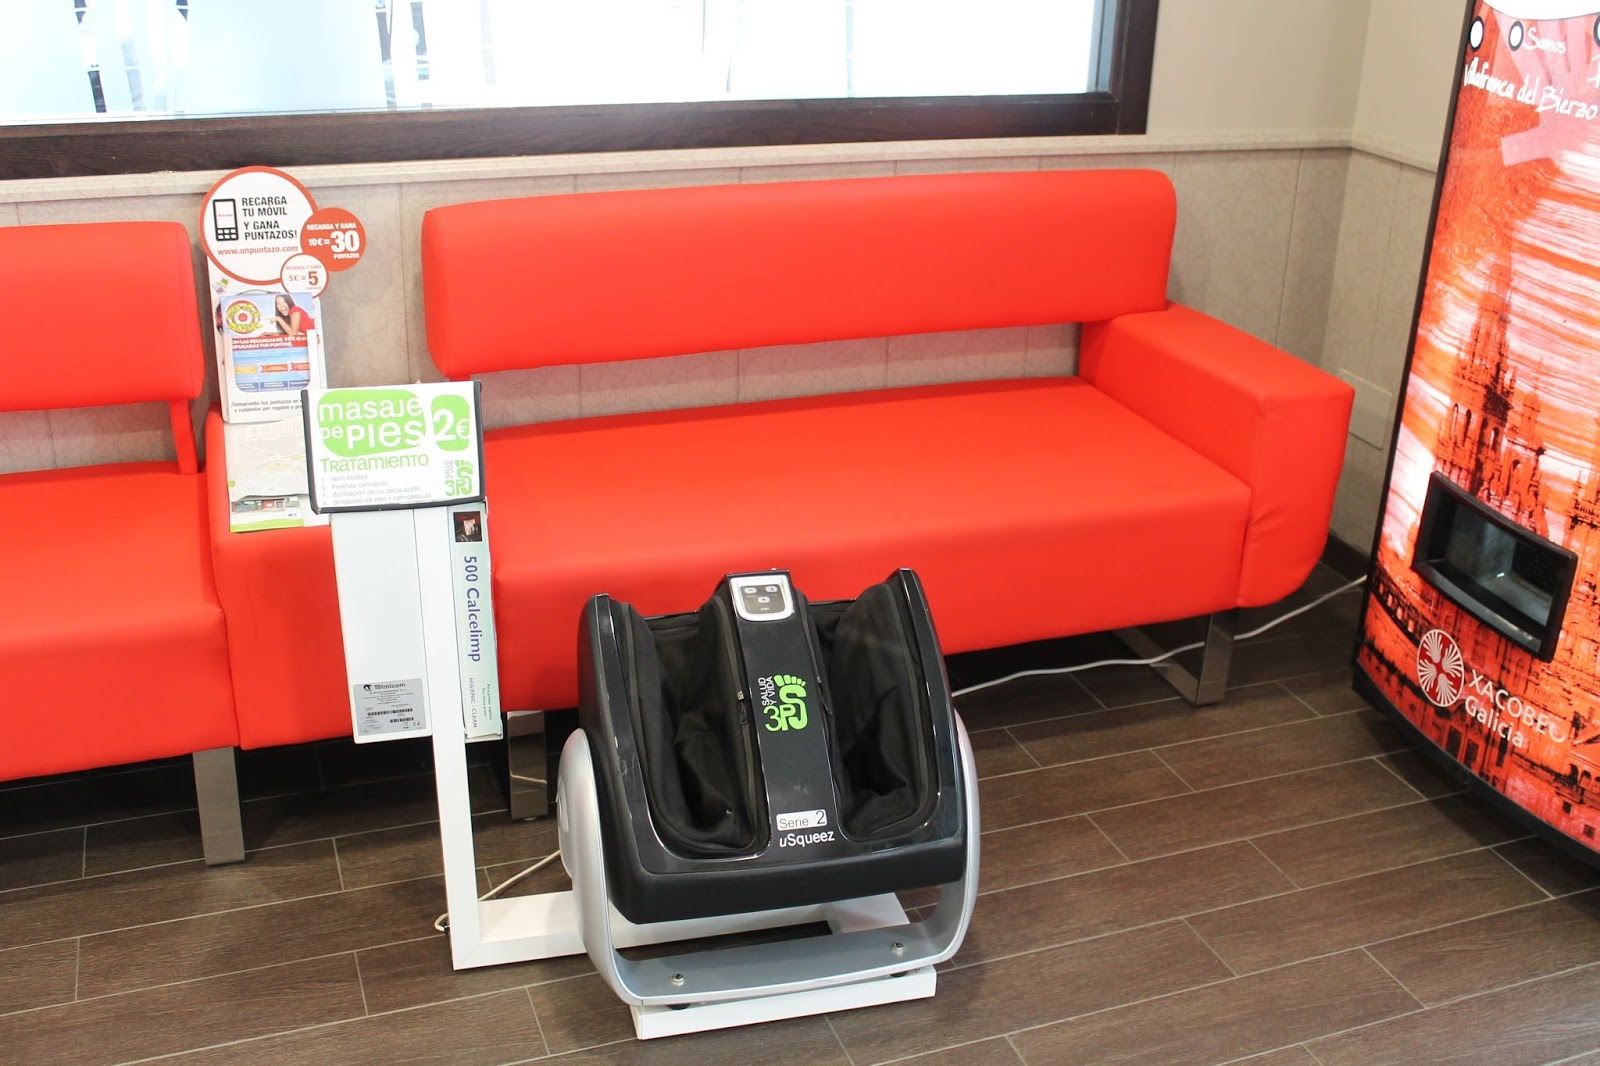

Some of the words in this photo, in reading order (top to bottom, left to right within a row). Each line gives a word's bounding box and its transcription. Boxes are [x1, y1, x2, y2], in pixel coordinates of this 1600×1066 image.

[1523, 27, 1566, 54] Samos
[1517, 74, 1539, 105] del
[1535, 86, 1598, 120] Bierzo
[242, 196, 288, 206] RECARGA
[242, 208, 254, 217] TU
[243, 222, 249, 230] Y
[253, 220, 280, 229] GANA
[245, 230, 297, 240] PUNTAZOS!
[217, 245, 299, 256] www.unpuntazo.com
[308, 271, 318, 285] 5
[432, 408, 470, 441] 2€
[464, 556, 478, 582] 500
[467, 587, 482, 662] Calcelimp
[758, 677, 770, 706] SALUD
[765, 676, 776, 697] VIDA
[1465, 696, 1524, 748] Galicia
[779, 817, 809, 829] Serie
[816, 810, 825, 825] 2
[779, 831, 835, 848] uSqueez
